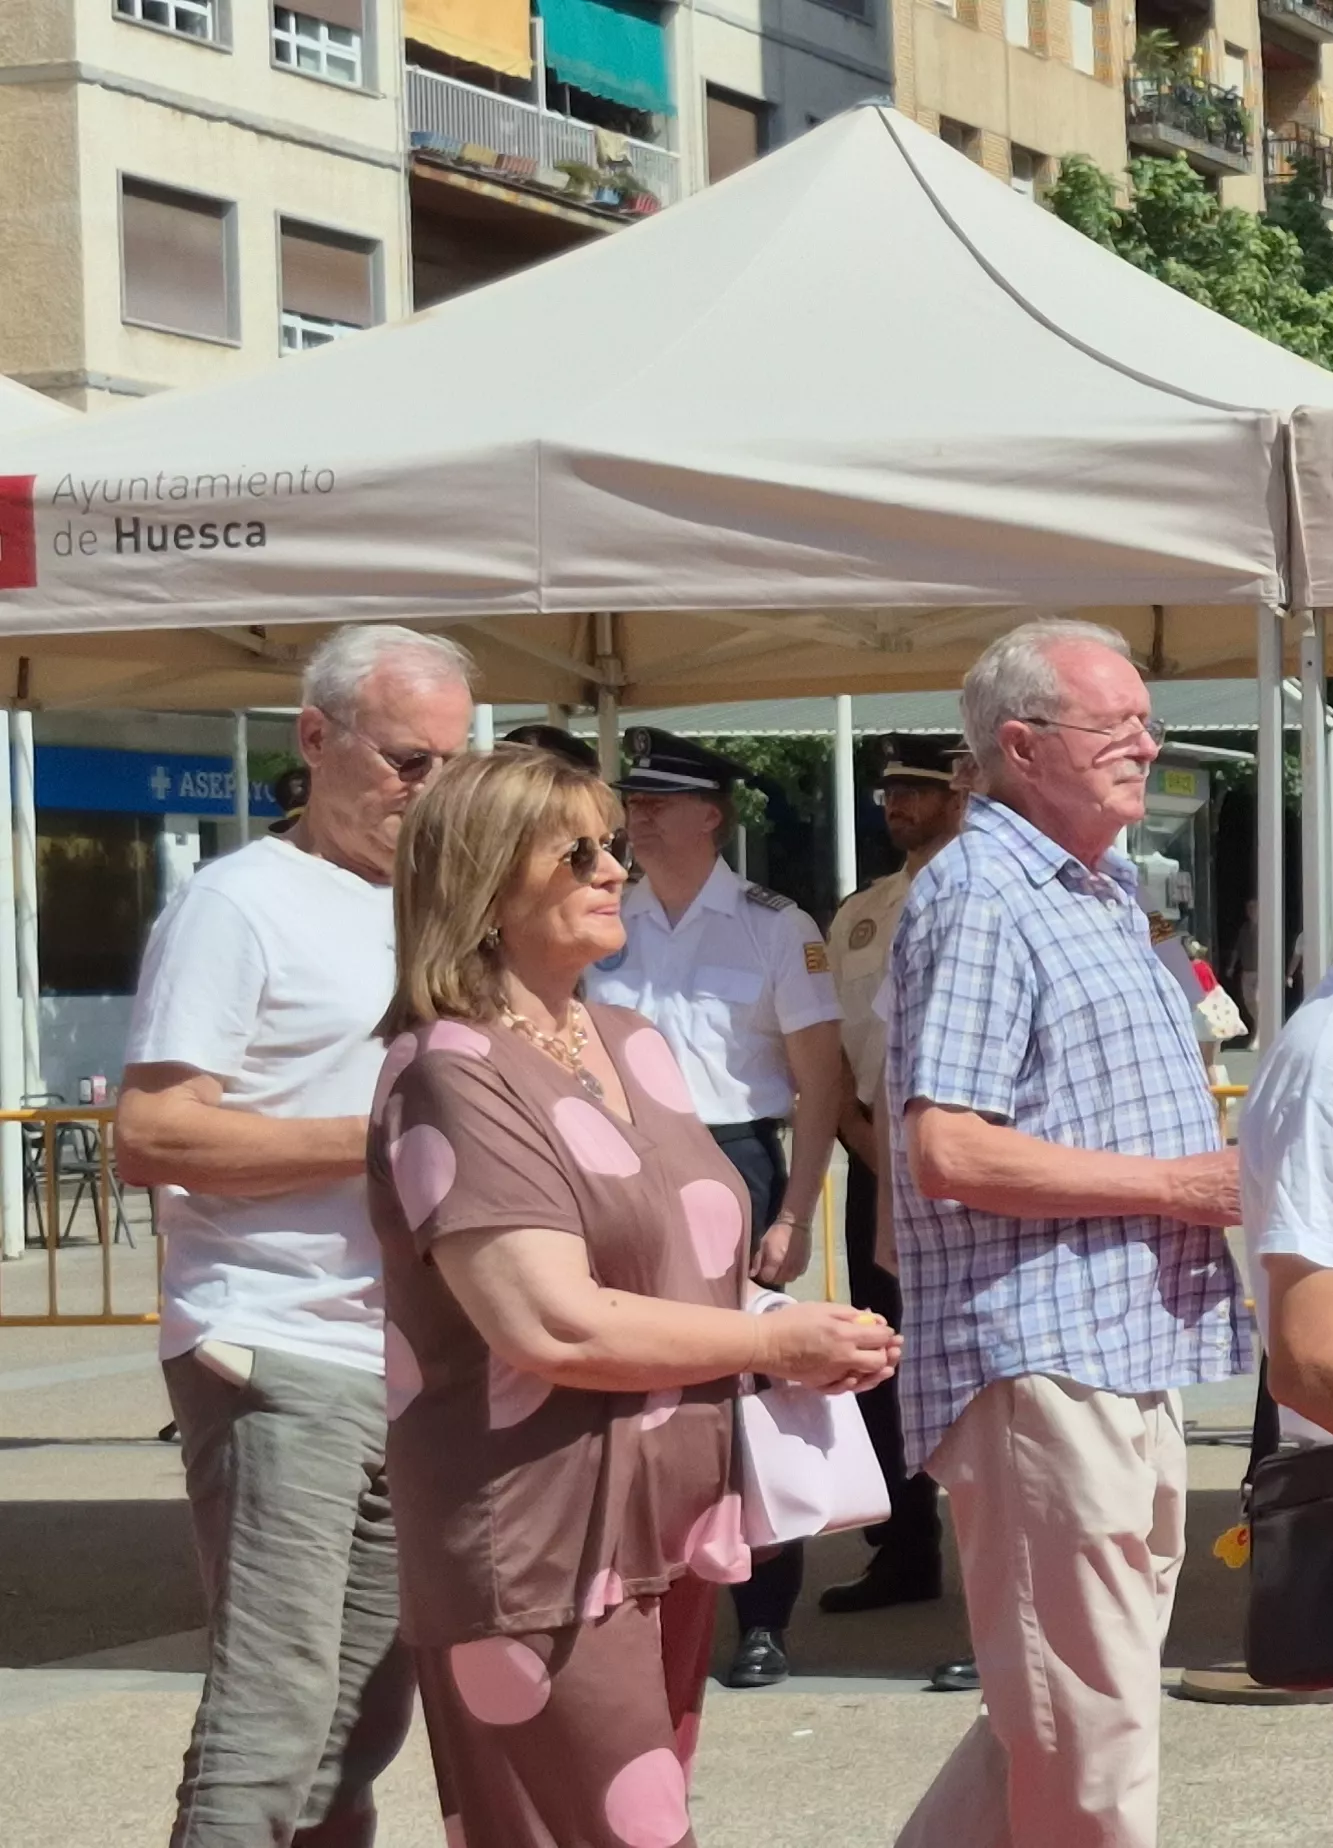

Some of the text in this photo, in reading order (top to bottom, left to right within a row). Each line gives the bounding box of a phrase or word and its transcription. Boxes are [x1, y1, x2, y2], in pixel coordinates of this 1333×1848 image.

[52, 464, 336, 515] Ayuntamiento
[53, 516, 267, 556] de Huesca
